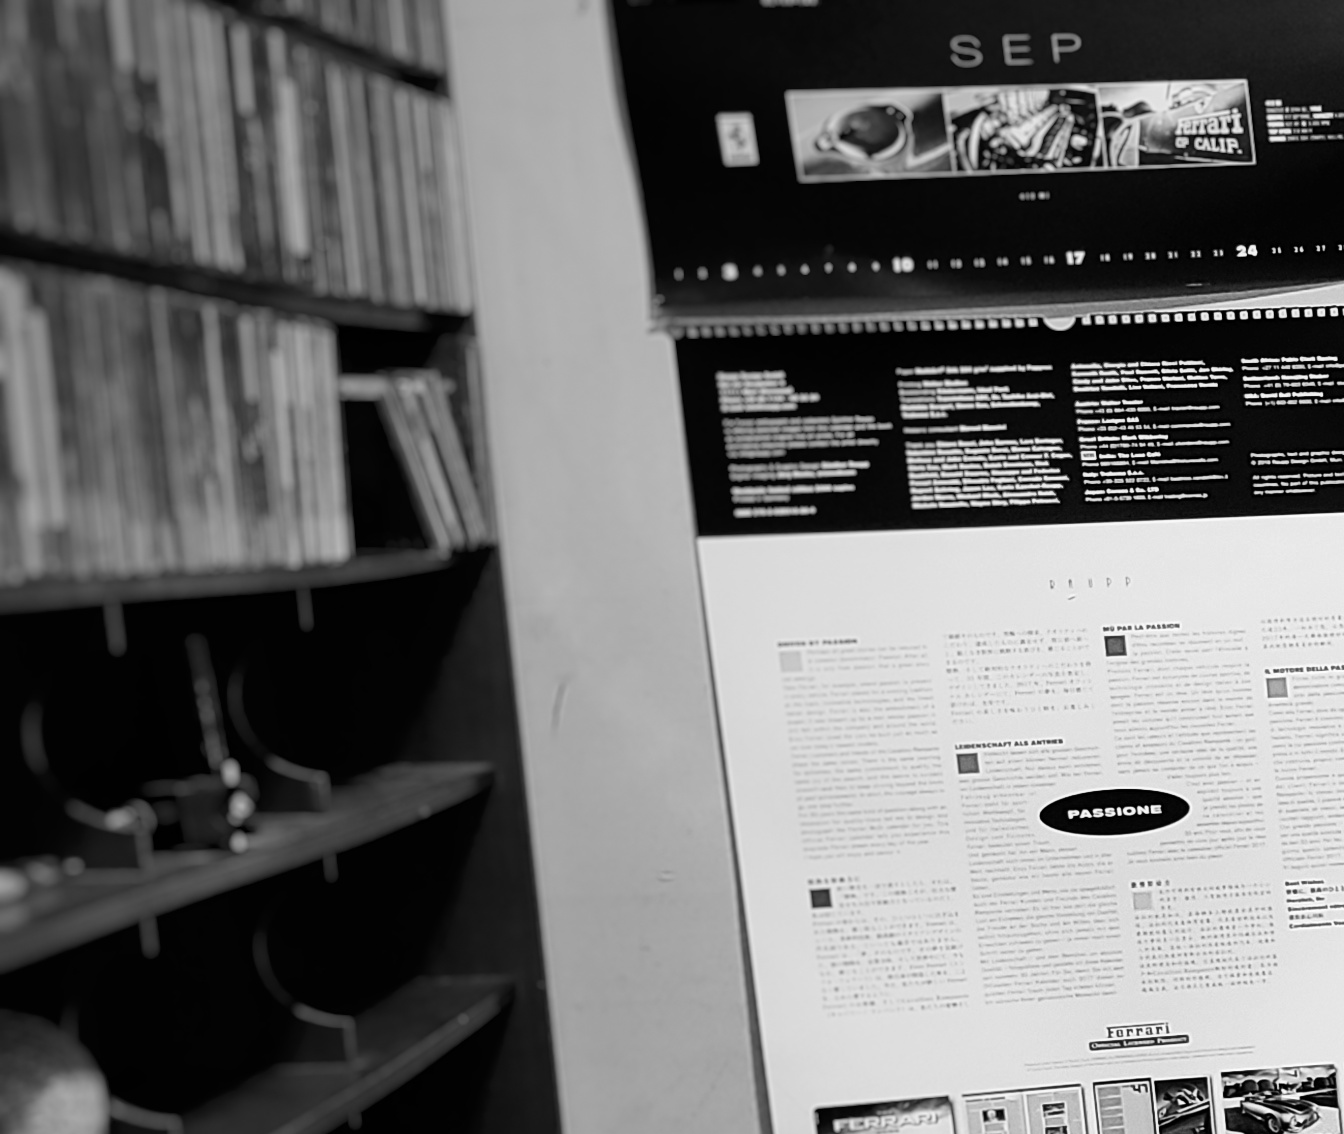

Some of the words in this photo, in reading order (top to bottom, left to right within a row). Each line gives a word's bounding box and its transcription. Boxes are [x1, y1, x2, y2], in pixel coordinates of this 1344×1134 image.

[949, 33, 1082, 68] SEP
[1174, 107, 1244, 136] Ferrari
[891, 256, 915, 274] 10
[1065, 250, 1086, 266] 17
[1235, 244, 1259, 258] 24
[1145, 622, 1181, 631] PASSION
[1272, 665, 1304, 675] MOTORE
[1306, 664, 1329, 673] DELLA
[954, 740, 1012, 751] LEIDENSCHAFT
[1013, 739, 1029, 747] ALS
[1030, 738, 1064, 746] ANTRIEB
[1066, 804, 1164, 821] PASSIONE
[1105, 1021, 1171, 1039] Ferrari
[832, 1111, 940, 1134] FERRARI
